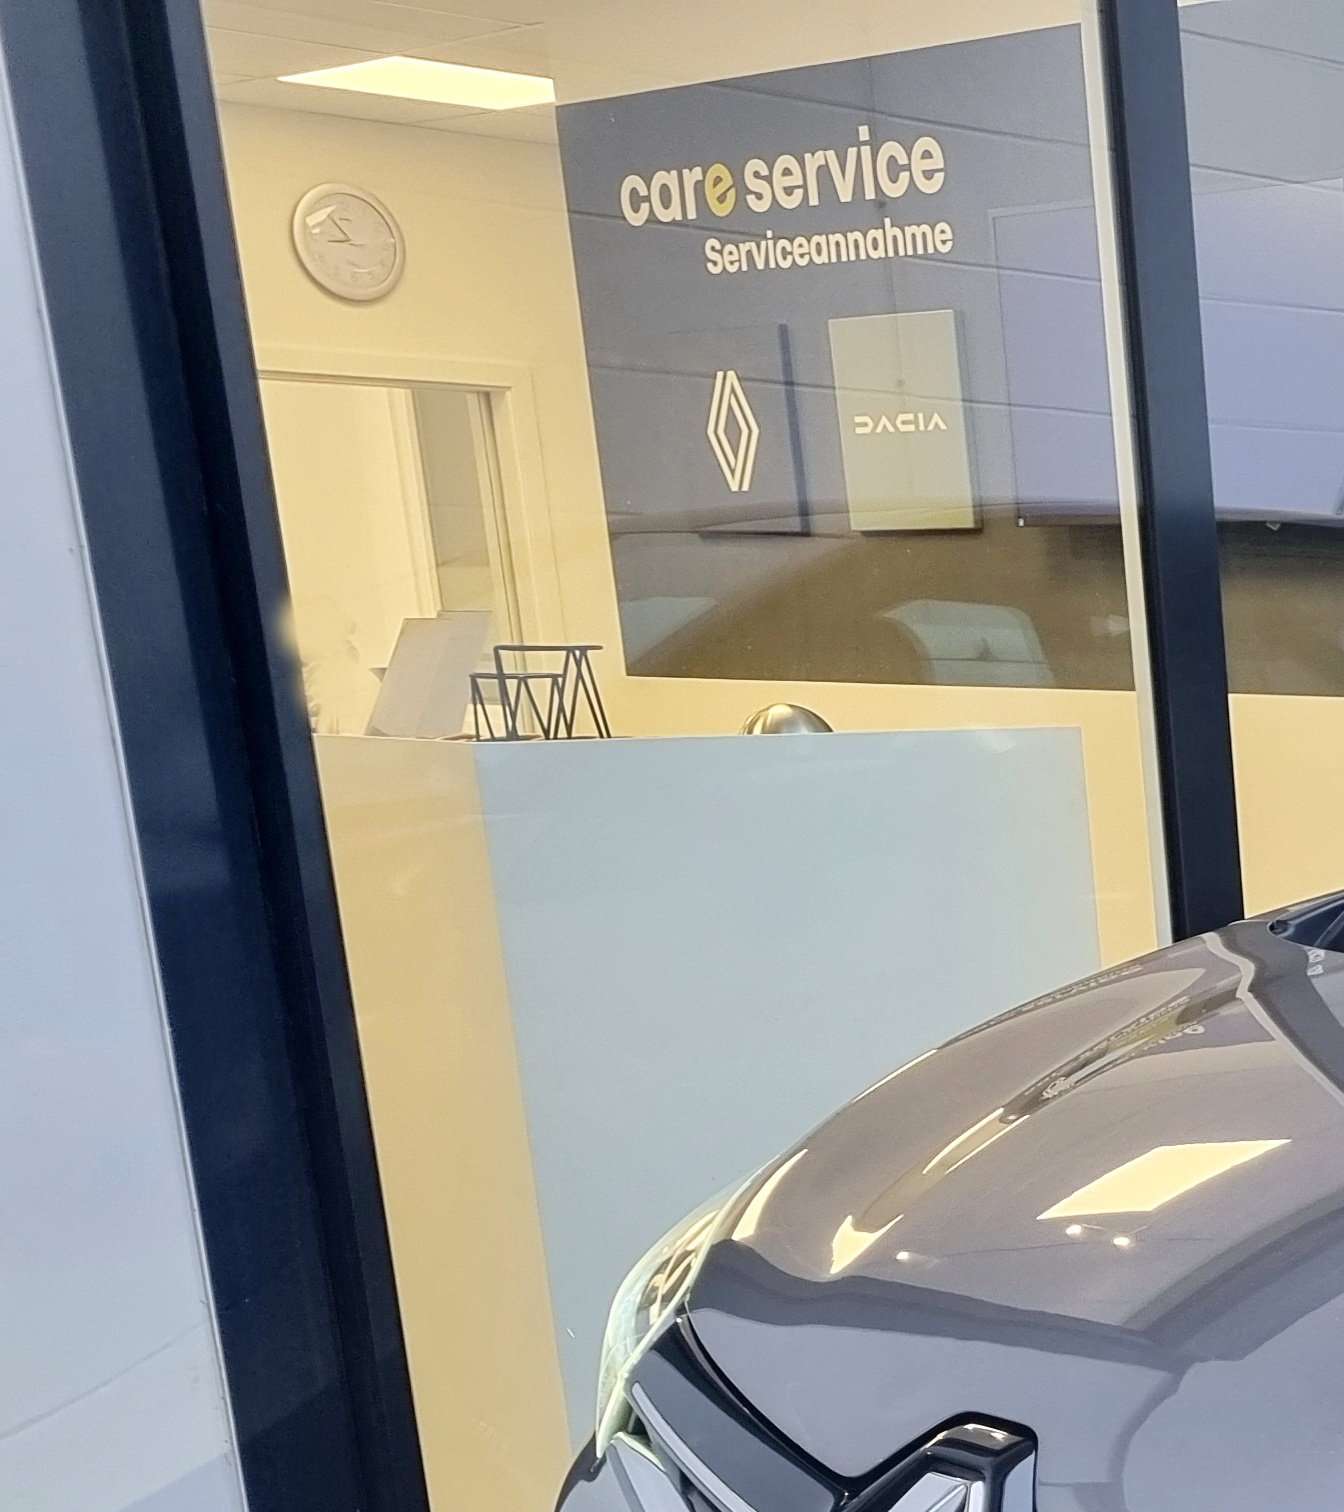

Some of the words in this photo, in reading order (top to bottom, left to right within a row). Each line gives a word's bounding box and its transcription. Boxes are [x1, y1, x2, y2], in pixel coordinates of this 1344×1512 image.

[620, 162, 736, 227] care
[743, 125, 945, 213] service
[704, 217, 953, 275] Serviceannahme
[854, 413, 948, 435] DACIA
